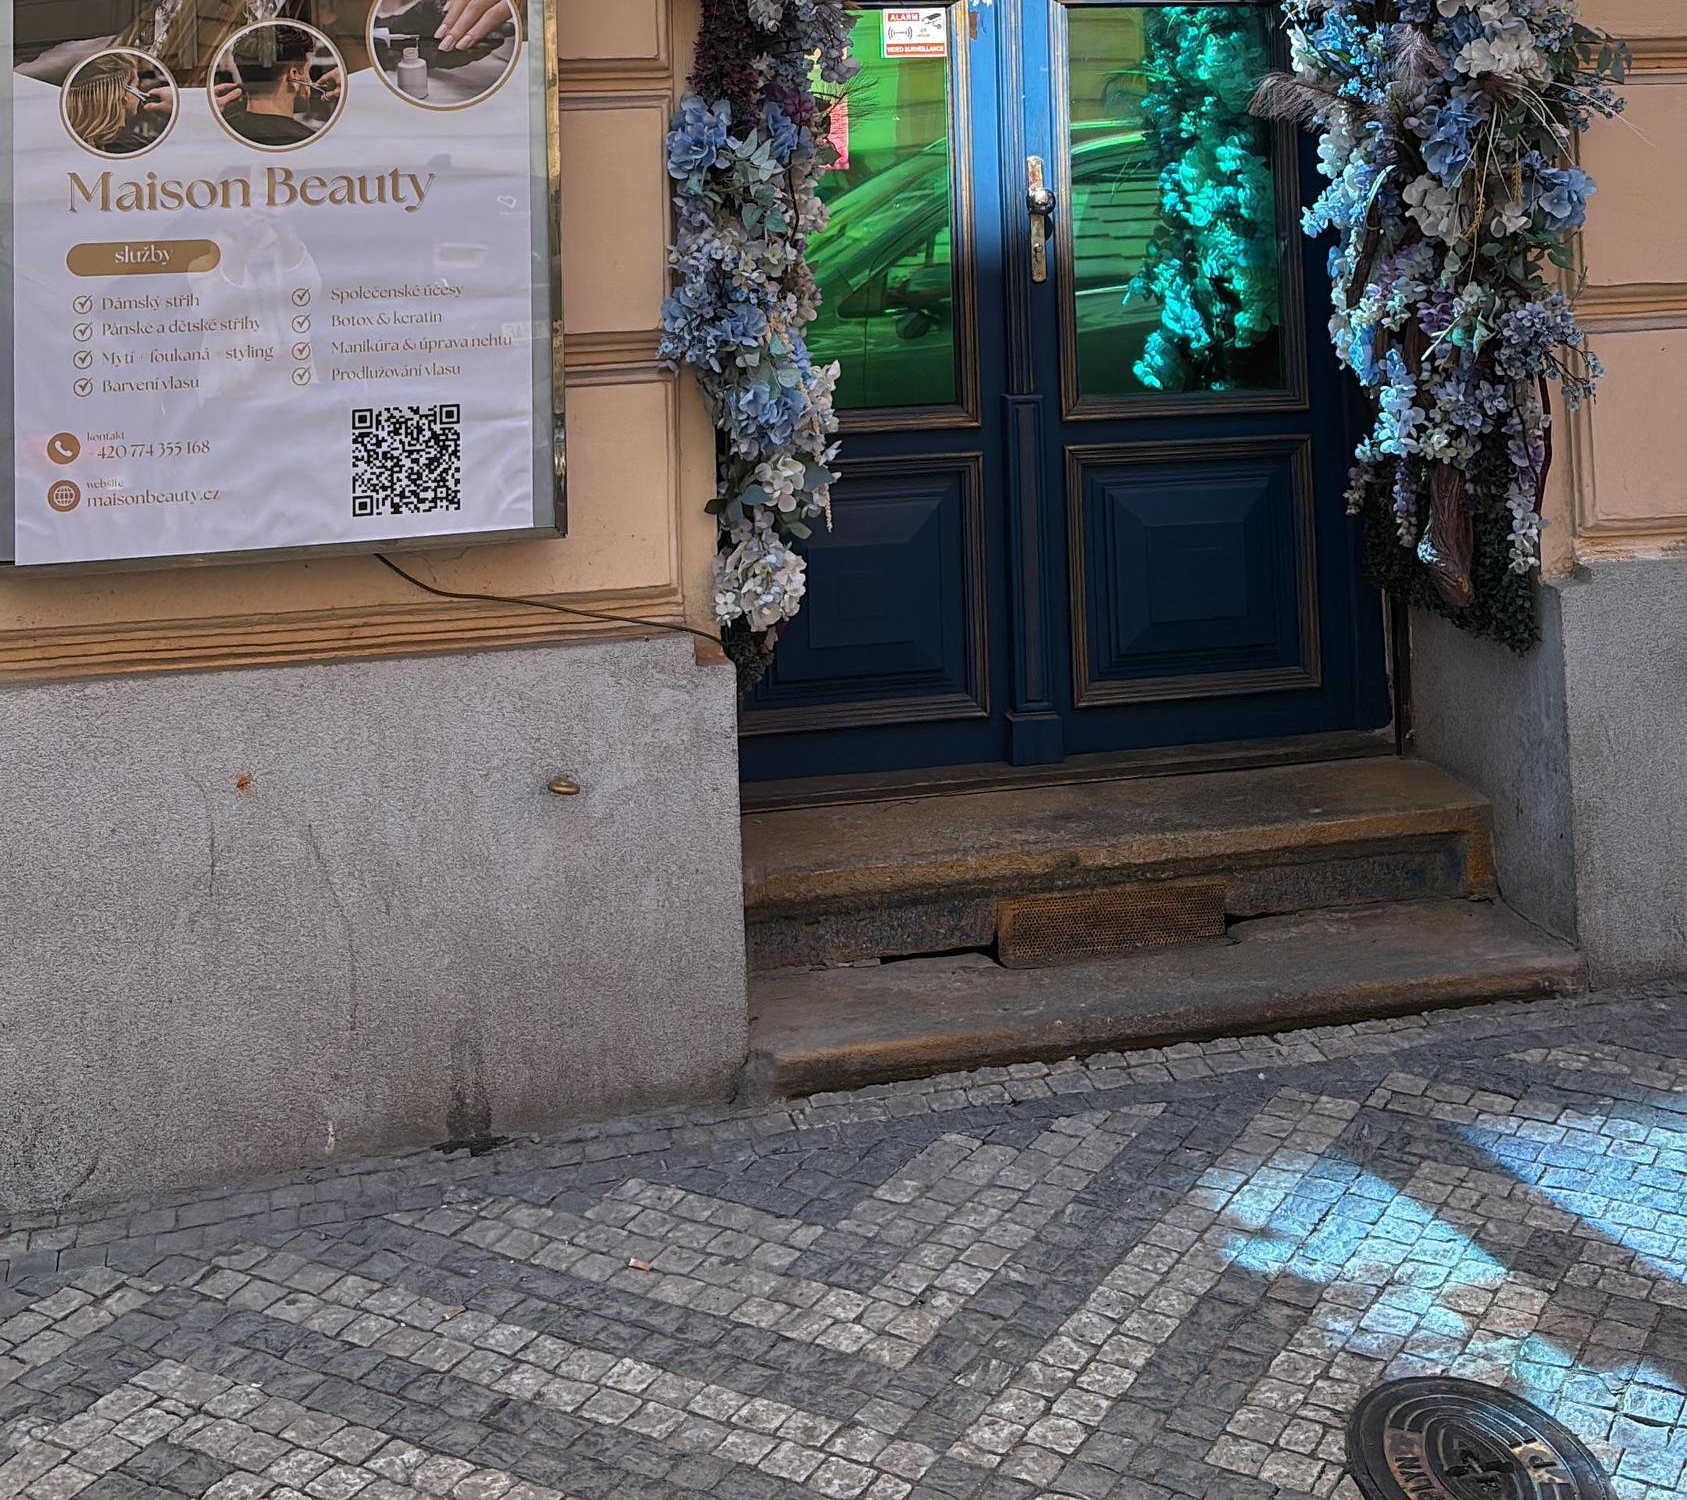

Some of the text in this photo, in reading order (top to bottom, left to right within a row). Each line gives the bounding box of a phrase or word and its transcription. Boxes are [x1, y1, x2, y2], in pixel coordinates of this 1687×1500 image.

[890, 13, 918, 21] ALARM
[904, 45, 945, 53] SURVEILLANCE
[67, 166, 436, 213] Maison Beauty
[114, 244, 174, 266] služby
[423, 282, 464, 298] účesy
[102, 293, 200, 311] Dámský střih
[156, 324, 165, 334] a
[168, 318, 217, 333] dětské
[220, 315, 261, 333] střihy
[331, 314, 374, 328] Botox
[376, 312, 391, 325] &
[149, 347, 210, 364] foukaná
[225, 344, 274, 362] styling
[331, 338, 399, 355] Manikúra
[402, 338, 417, 351] &
[420, 336, 469, 354] úprava
[331, 364, 422, 381] Prodlužování
[102, 377, 159, 393] Barvení
[86, 431, 125, 442] kontakt
[130, 443, 154, 458] 774
[159, 441, 182, 458] 355
[187, 440, 210, 454] 168
[86, 478, 124, 490] website
[86, 489, 220, 508] maisonbeauty.cz
